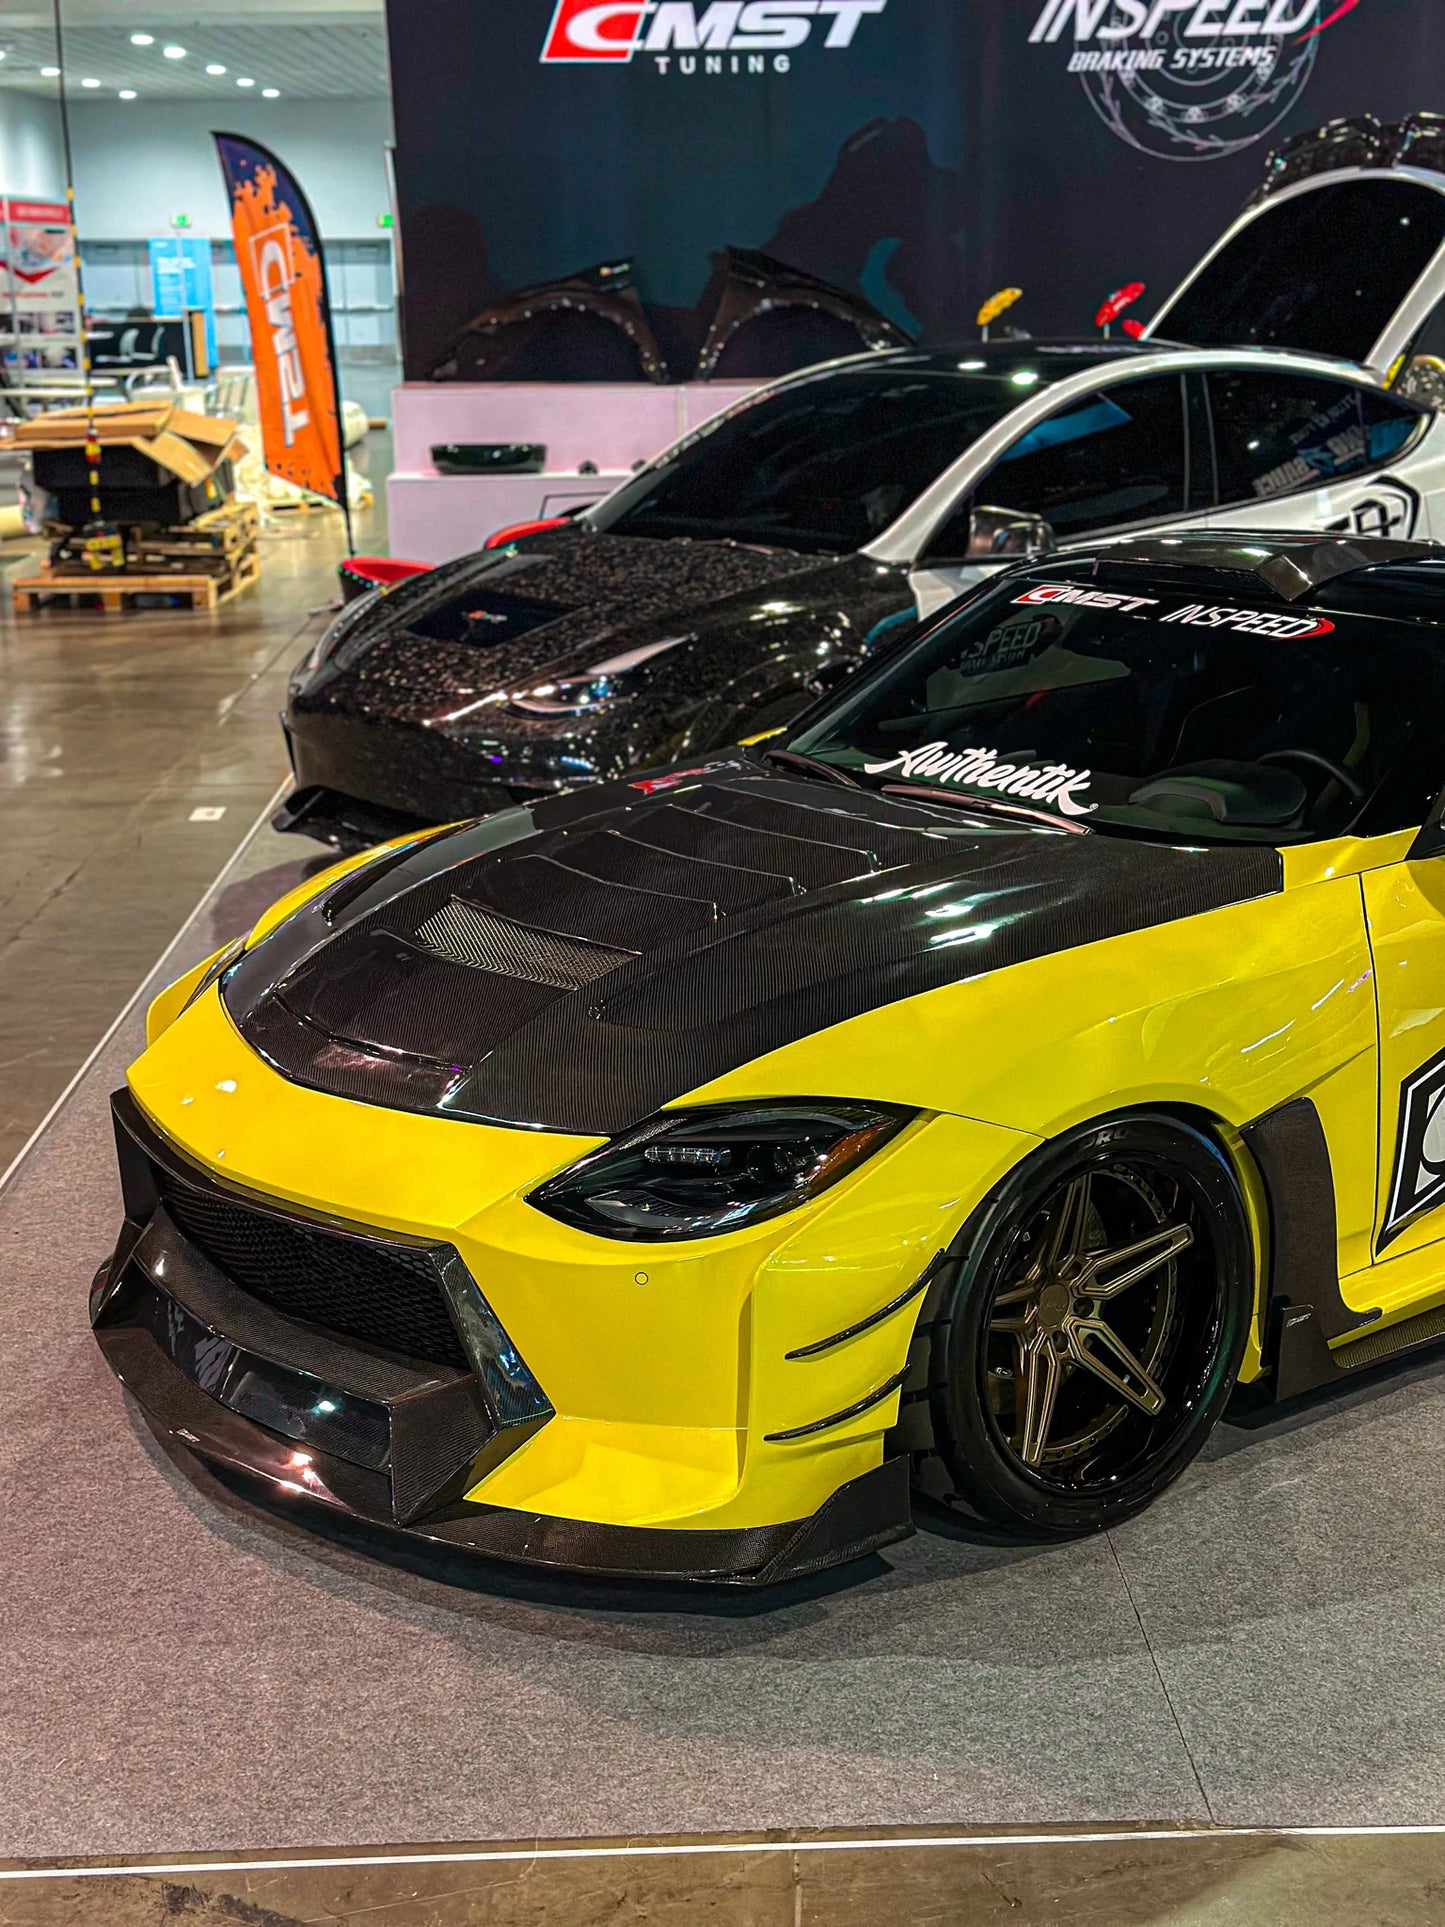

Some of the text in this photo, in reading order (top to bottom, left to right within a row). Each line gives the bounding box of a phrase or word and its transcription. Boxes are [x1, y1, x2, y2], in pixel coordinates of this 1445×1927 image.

[560, 0, 888, 51] CMST
[1028, 0, 1318, 42] INSPEED
[655, 55, 791, 74] TUNING
[1067, 46, 1278, 72] BRAKING SYSTEMS
[1022, 585, 1323, 638] CMST INSPEED
[864, 741, 1092, 815] Authentik
